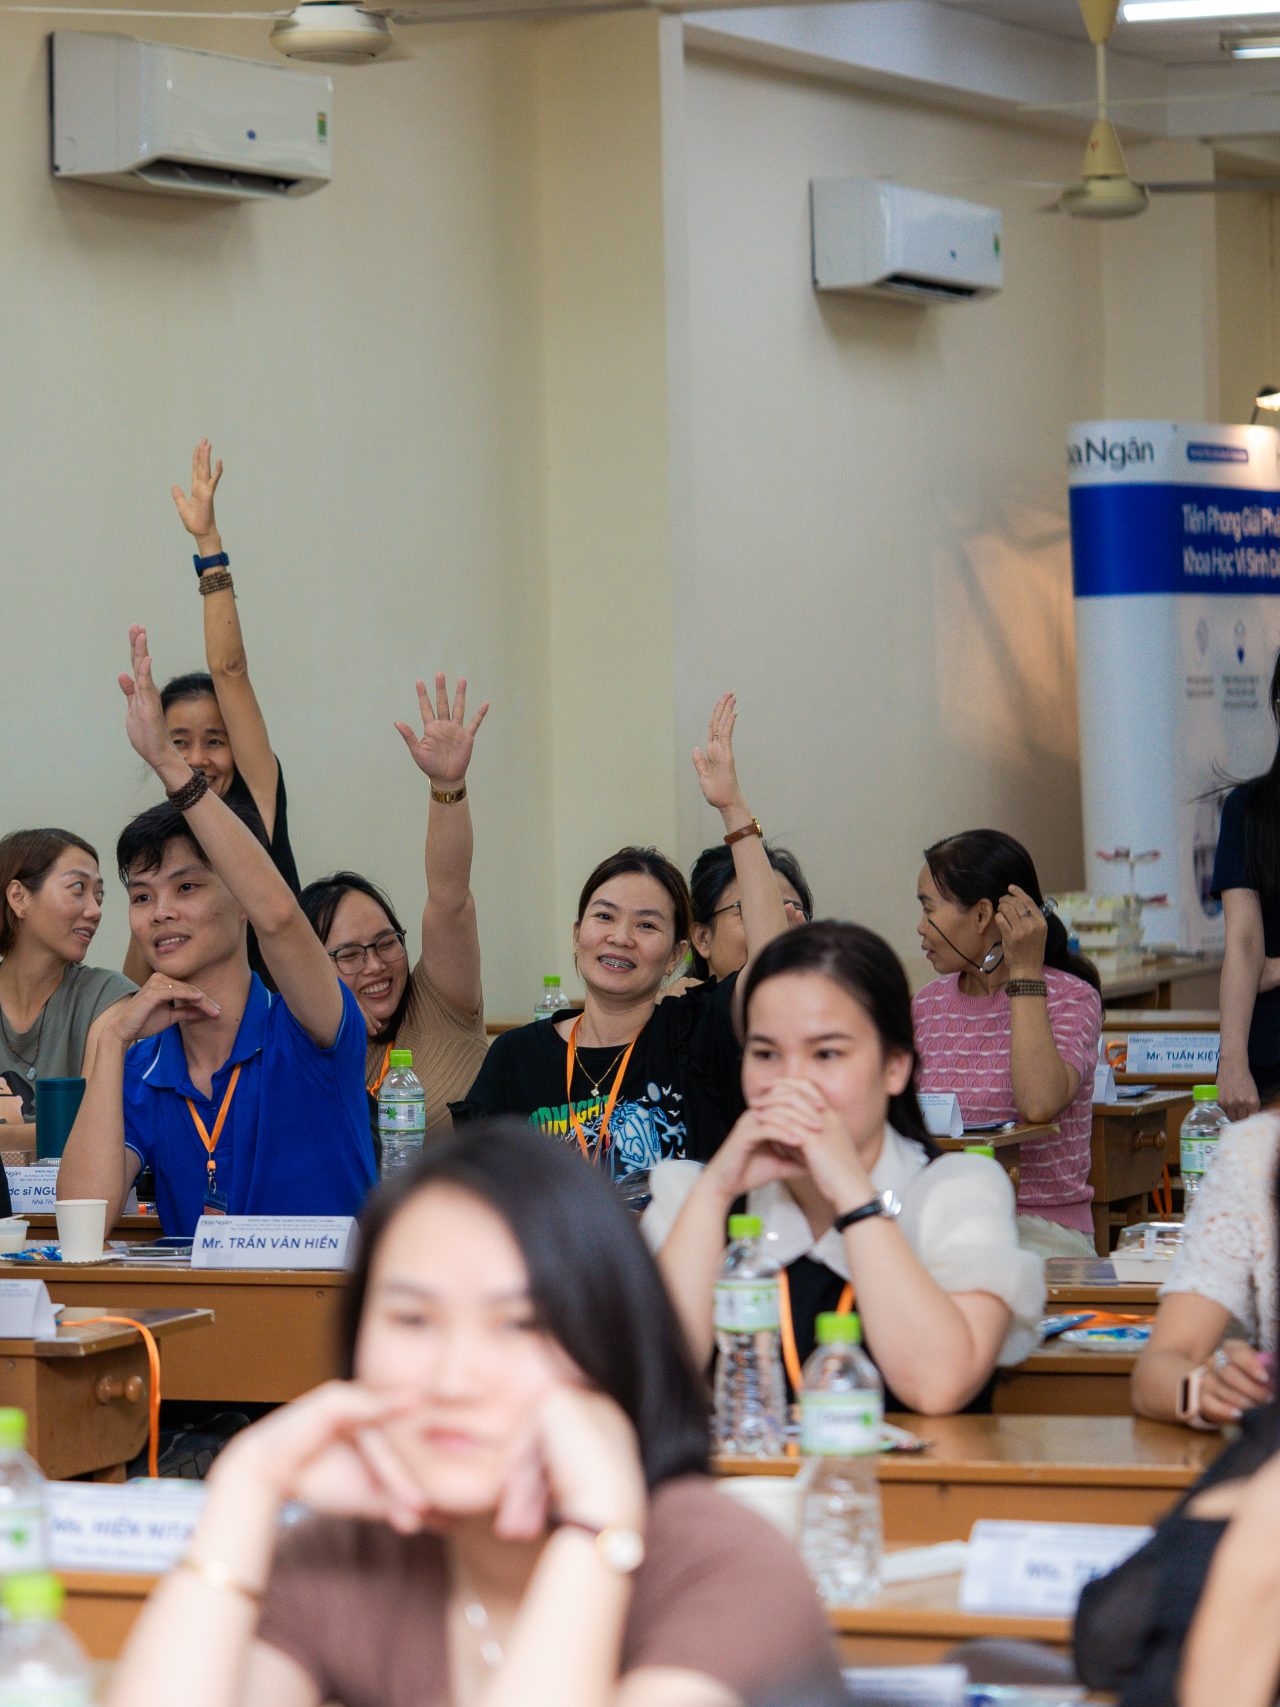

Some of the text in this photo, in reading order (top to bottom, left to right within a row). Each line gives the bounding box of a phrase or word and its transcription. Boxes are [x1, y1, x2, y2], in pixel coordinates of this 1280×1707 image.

[1207, 504, 1241, 543] Phong
[1183, 545, 1211, 577] Khoa
[1146, 1051, 1163, 1061] Mr.
[201, 1236, 224, 1249] Mr.
[271, 1234, 301, 1249] VĂN
